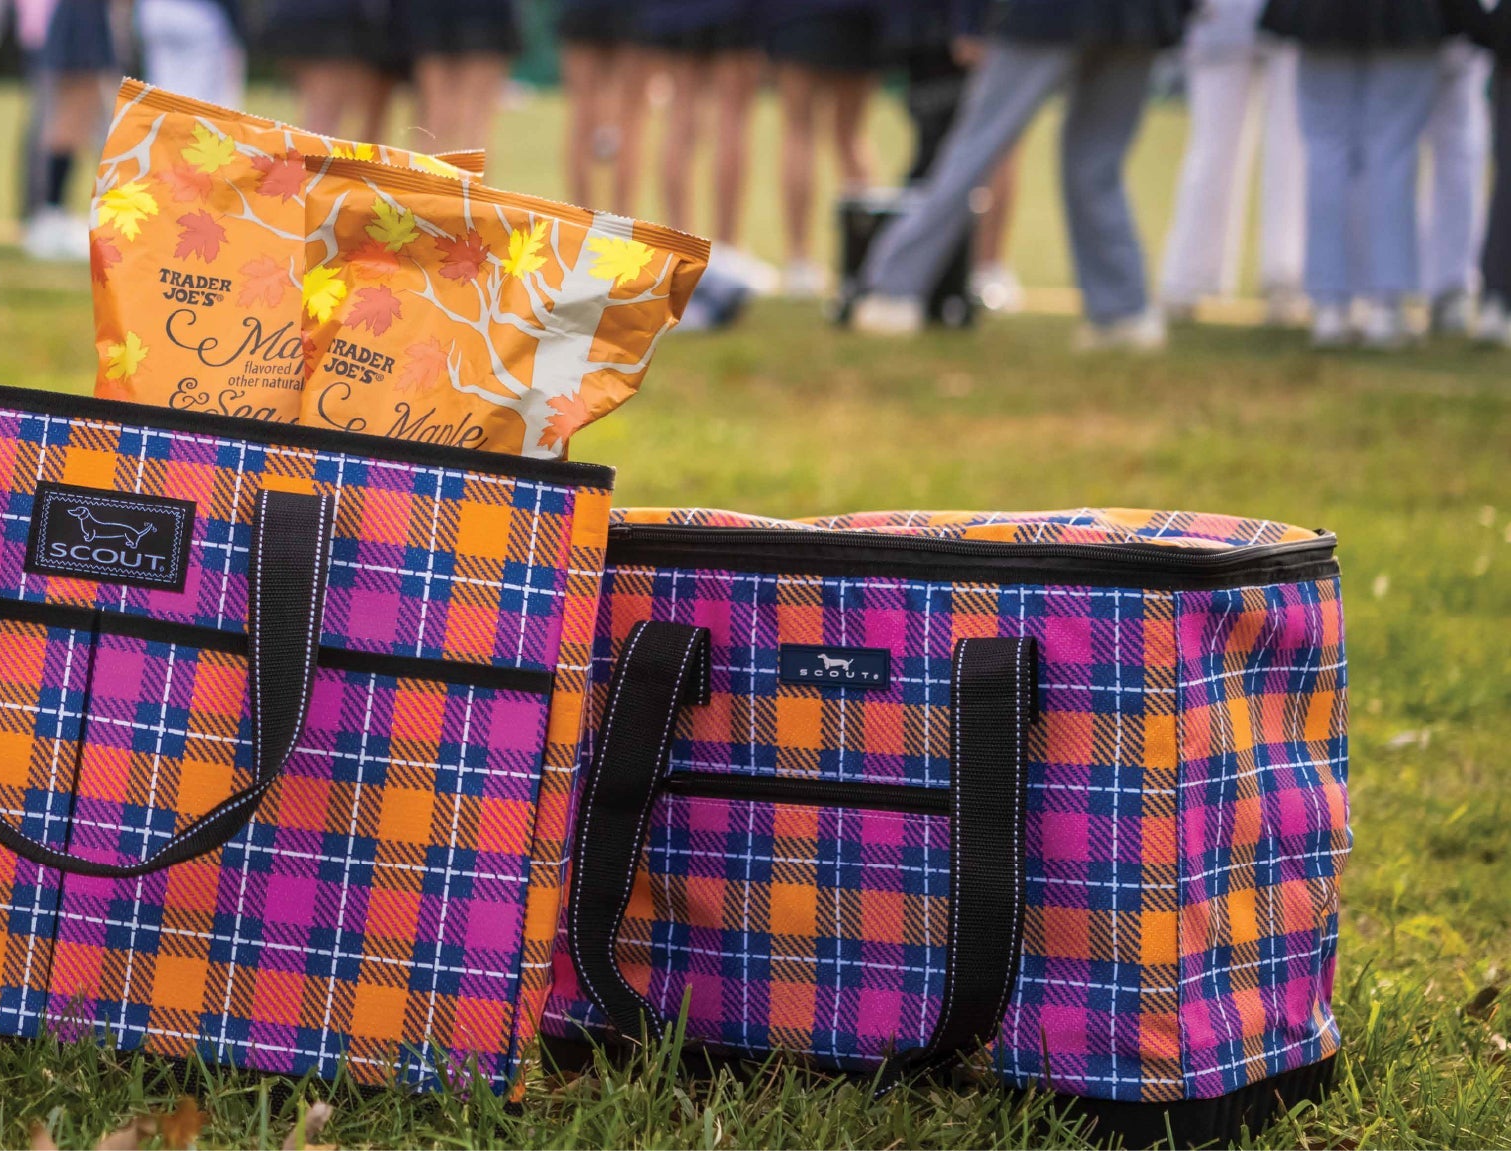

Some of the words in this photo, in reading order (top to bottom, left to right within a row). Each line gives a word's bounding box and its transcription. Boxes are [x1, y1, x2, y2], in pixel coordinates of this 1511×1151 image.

[159, 268, 232, 292] TRADER
[163, 288, 217, 306] JOE'S
[244, 361, 292, 375] flavored
[323, 357, 376, 384] JOE'S
[228, 375, 259, 388] other
[261, 378, 305, 391] natural
[49, 542, 166, 571] SCOUT
[799, 668, 869, 679] SCOUT
